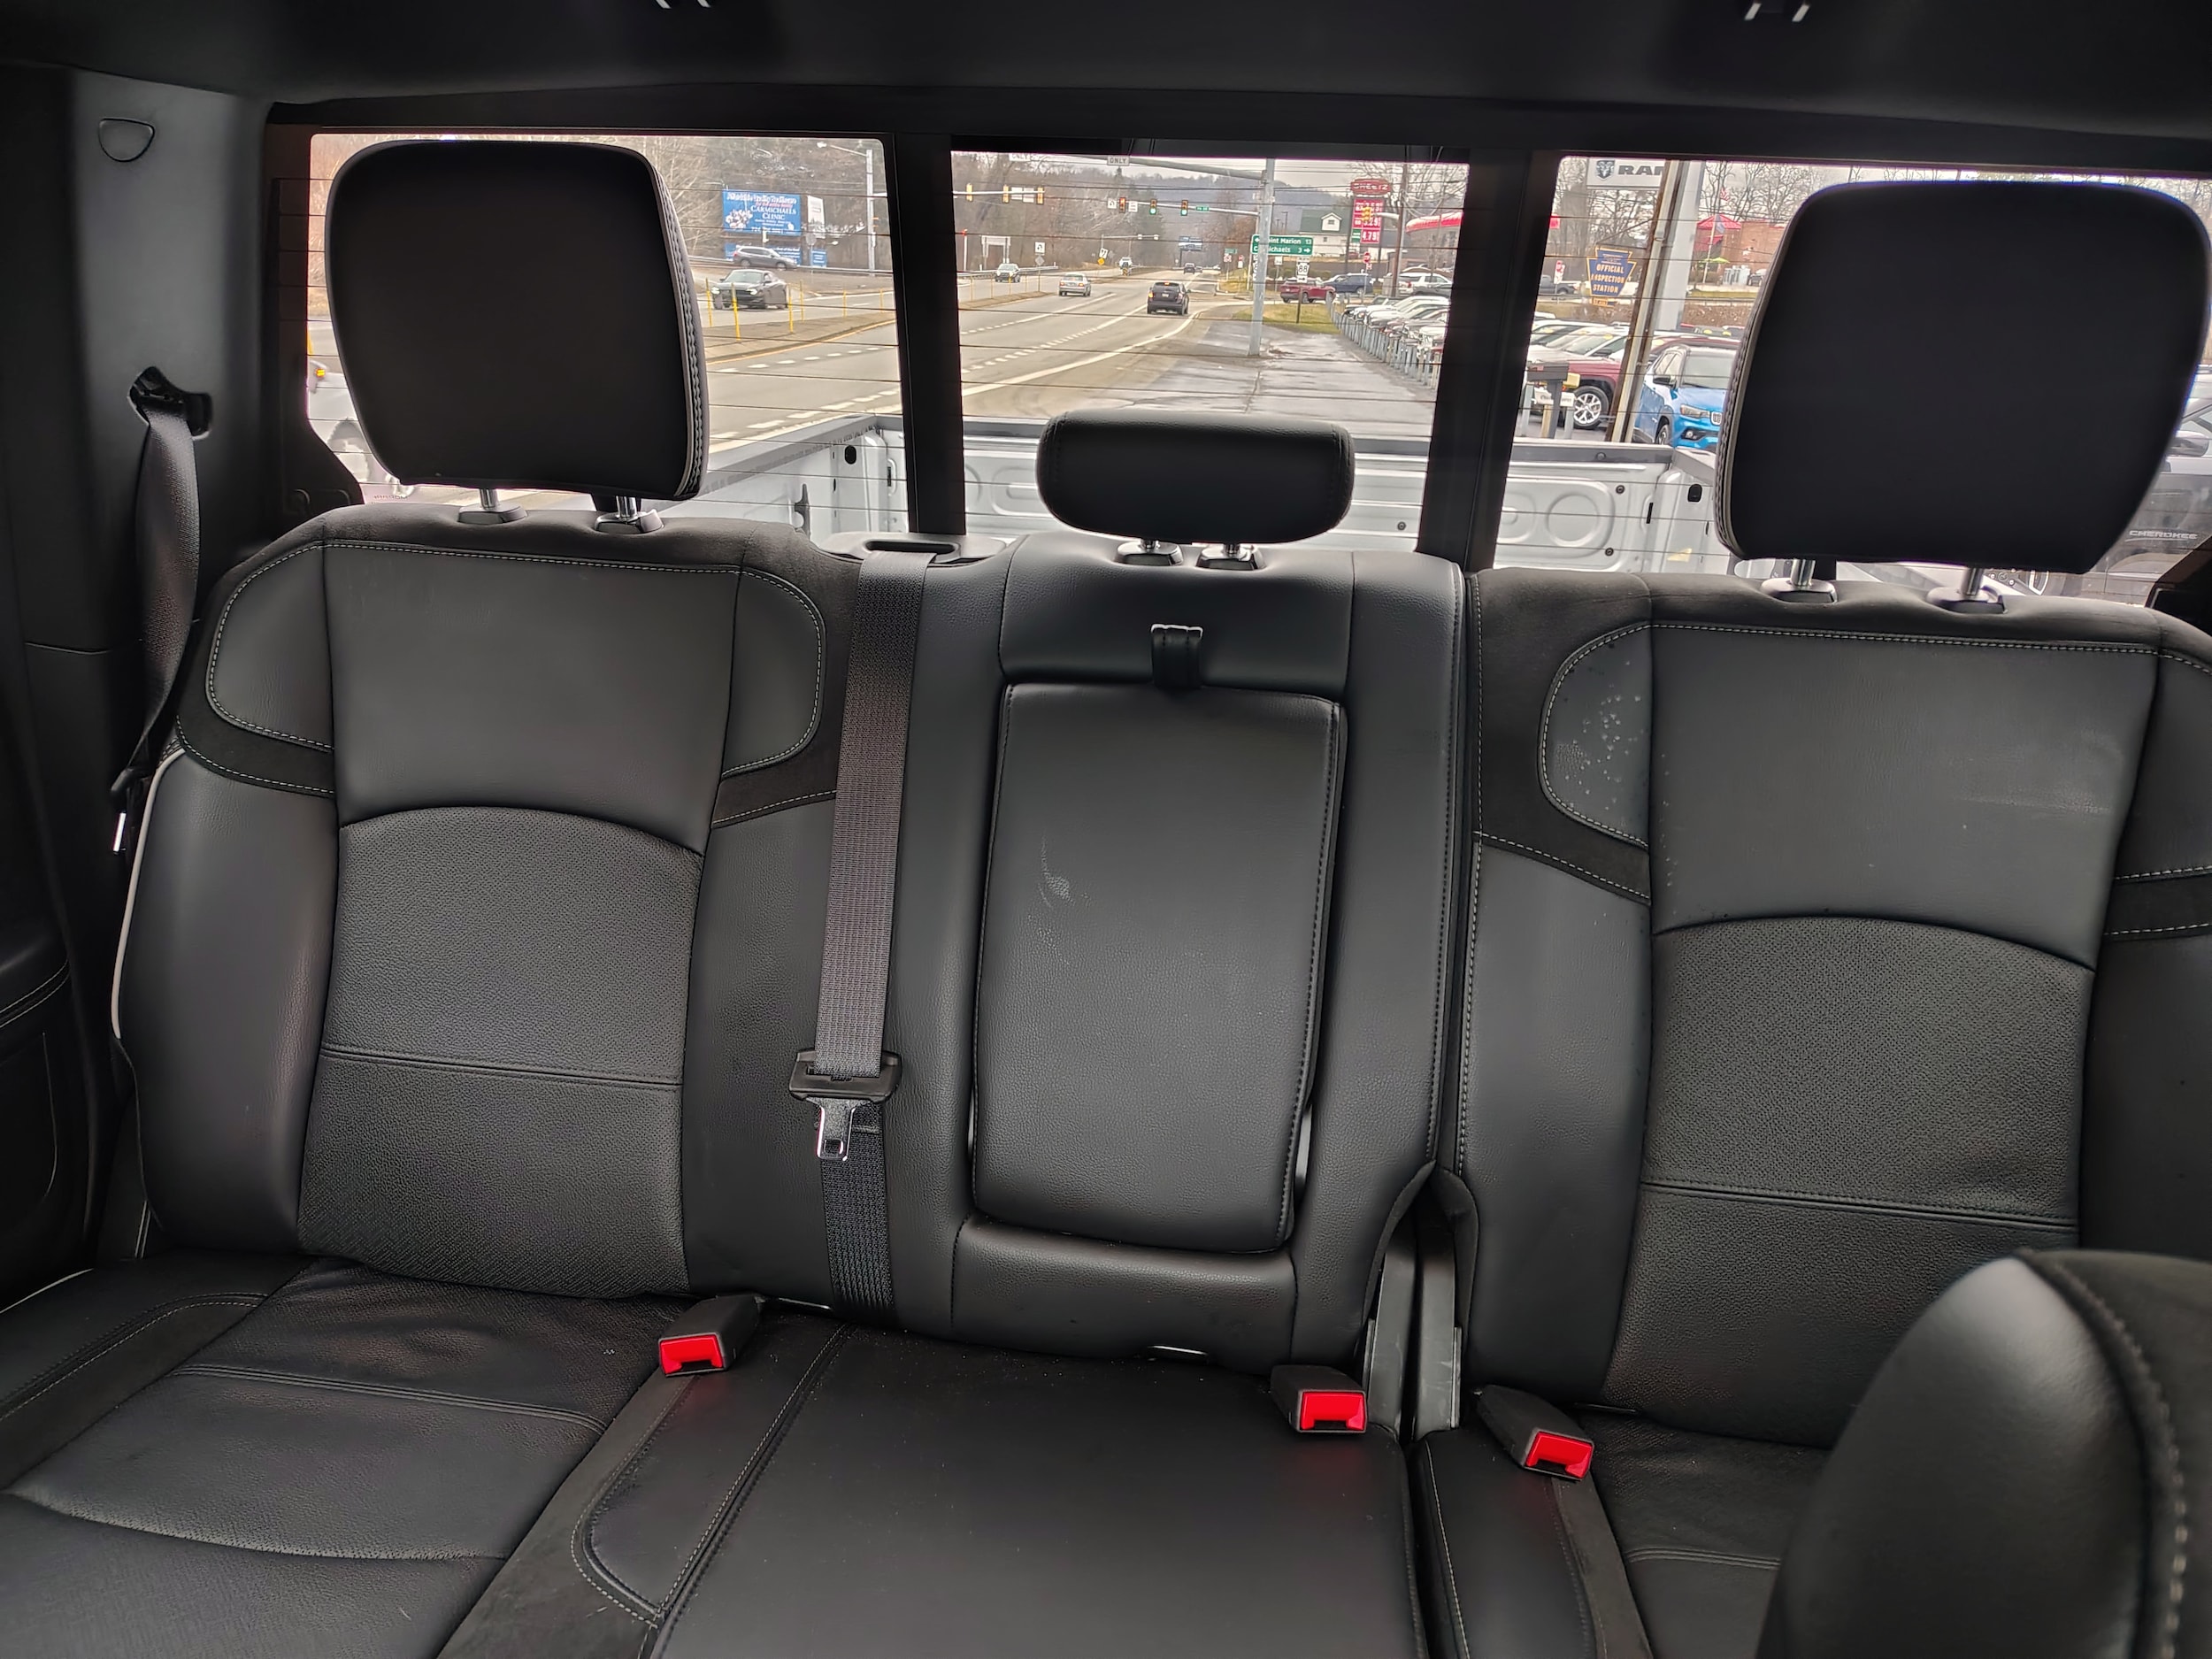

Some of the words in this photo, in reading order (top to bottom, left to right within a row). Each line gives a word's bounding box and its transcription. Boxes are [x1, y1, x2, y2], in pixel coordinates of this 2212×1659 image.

[1596, 264, 1624, 273] OFFICIAL
[1591, 273, 1625, 284] INSPECTION
[1593, 284, 1619, 294] STATION
[2129, 530, 2198, 540] CHEROKEE
